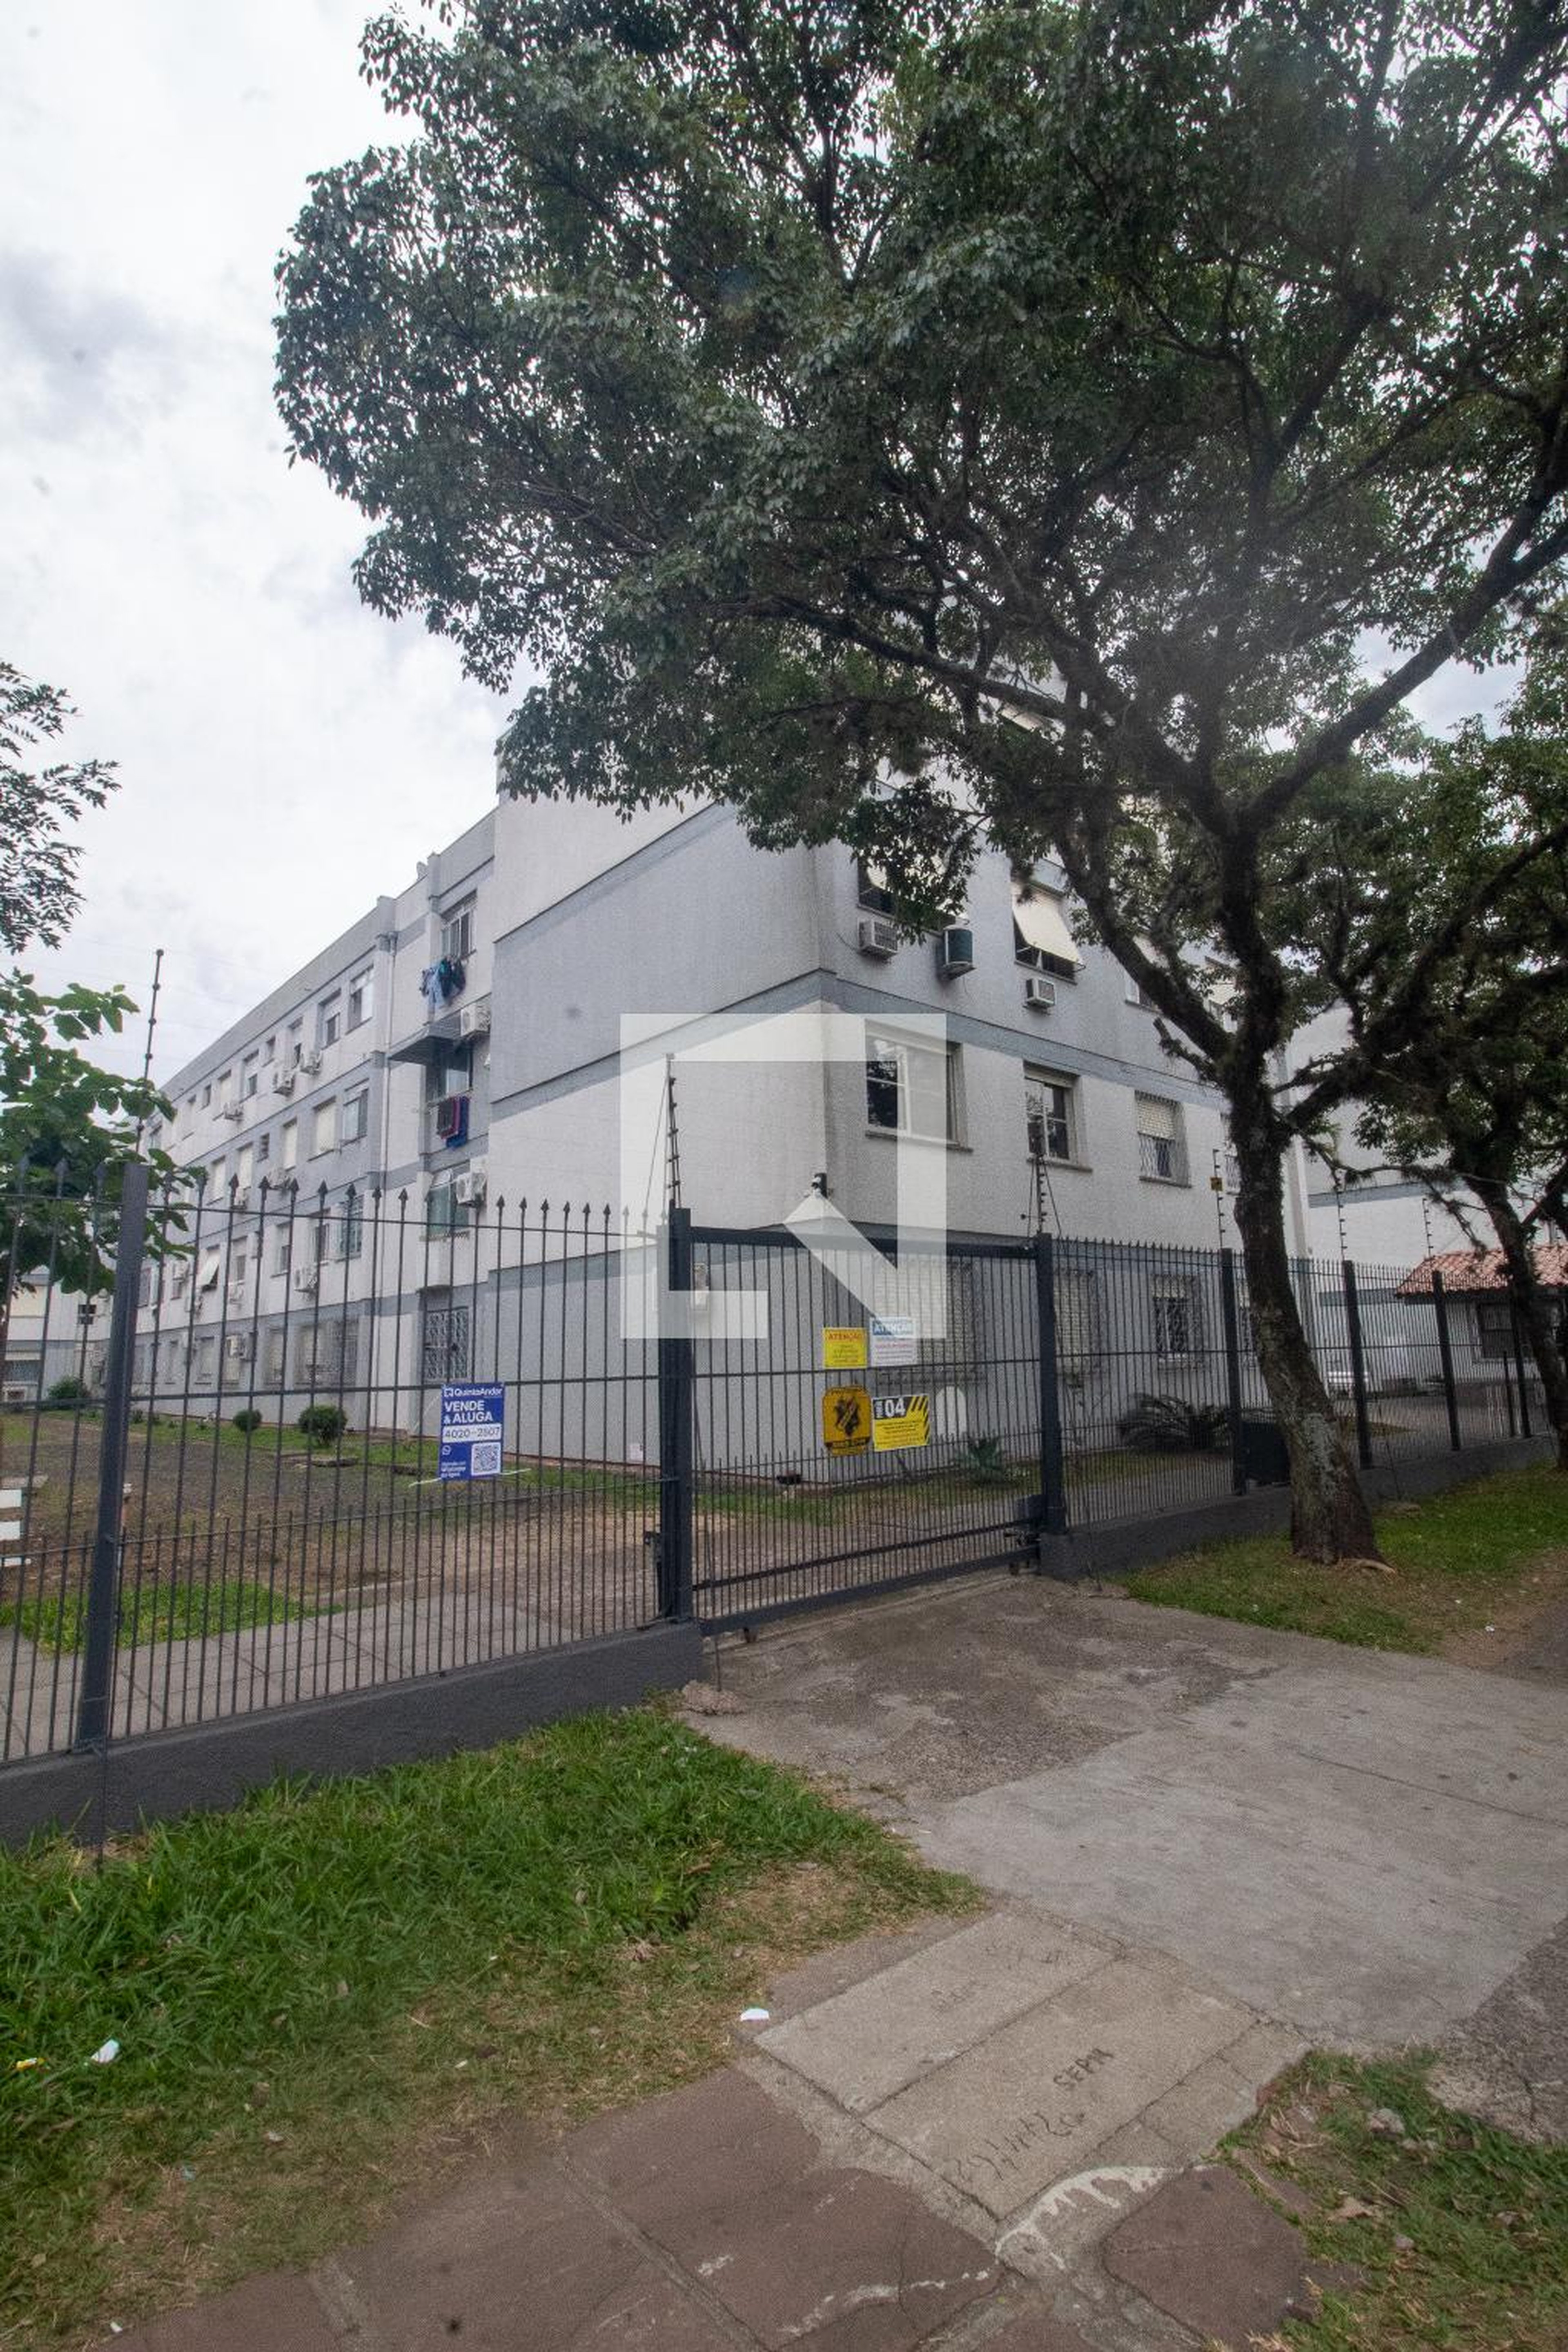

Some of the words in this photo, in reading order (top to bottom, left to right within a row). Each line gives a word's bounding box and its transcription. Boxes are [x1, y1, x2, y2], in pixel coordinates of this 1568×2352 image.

[444, 1400, 485, 1412] VENDE
[884, 1397, 906, 1417] 04
[443, 1414, 451, 1424] &
[452, 1411, 493, 1423] ALUGA
